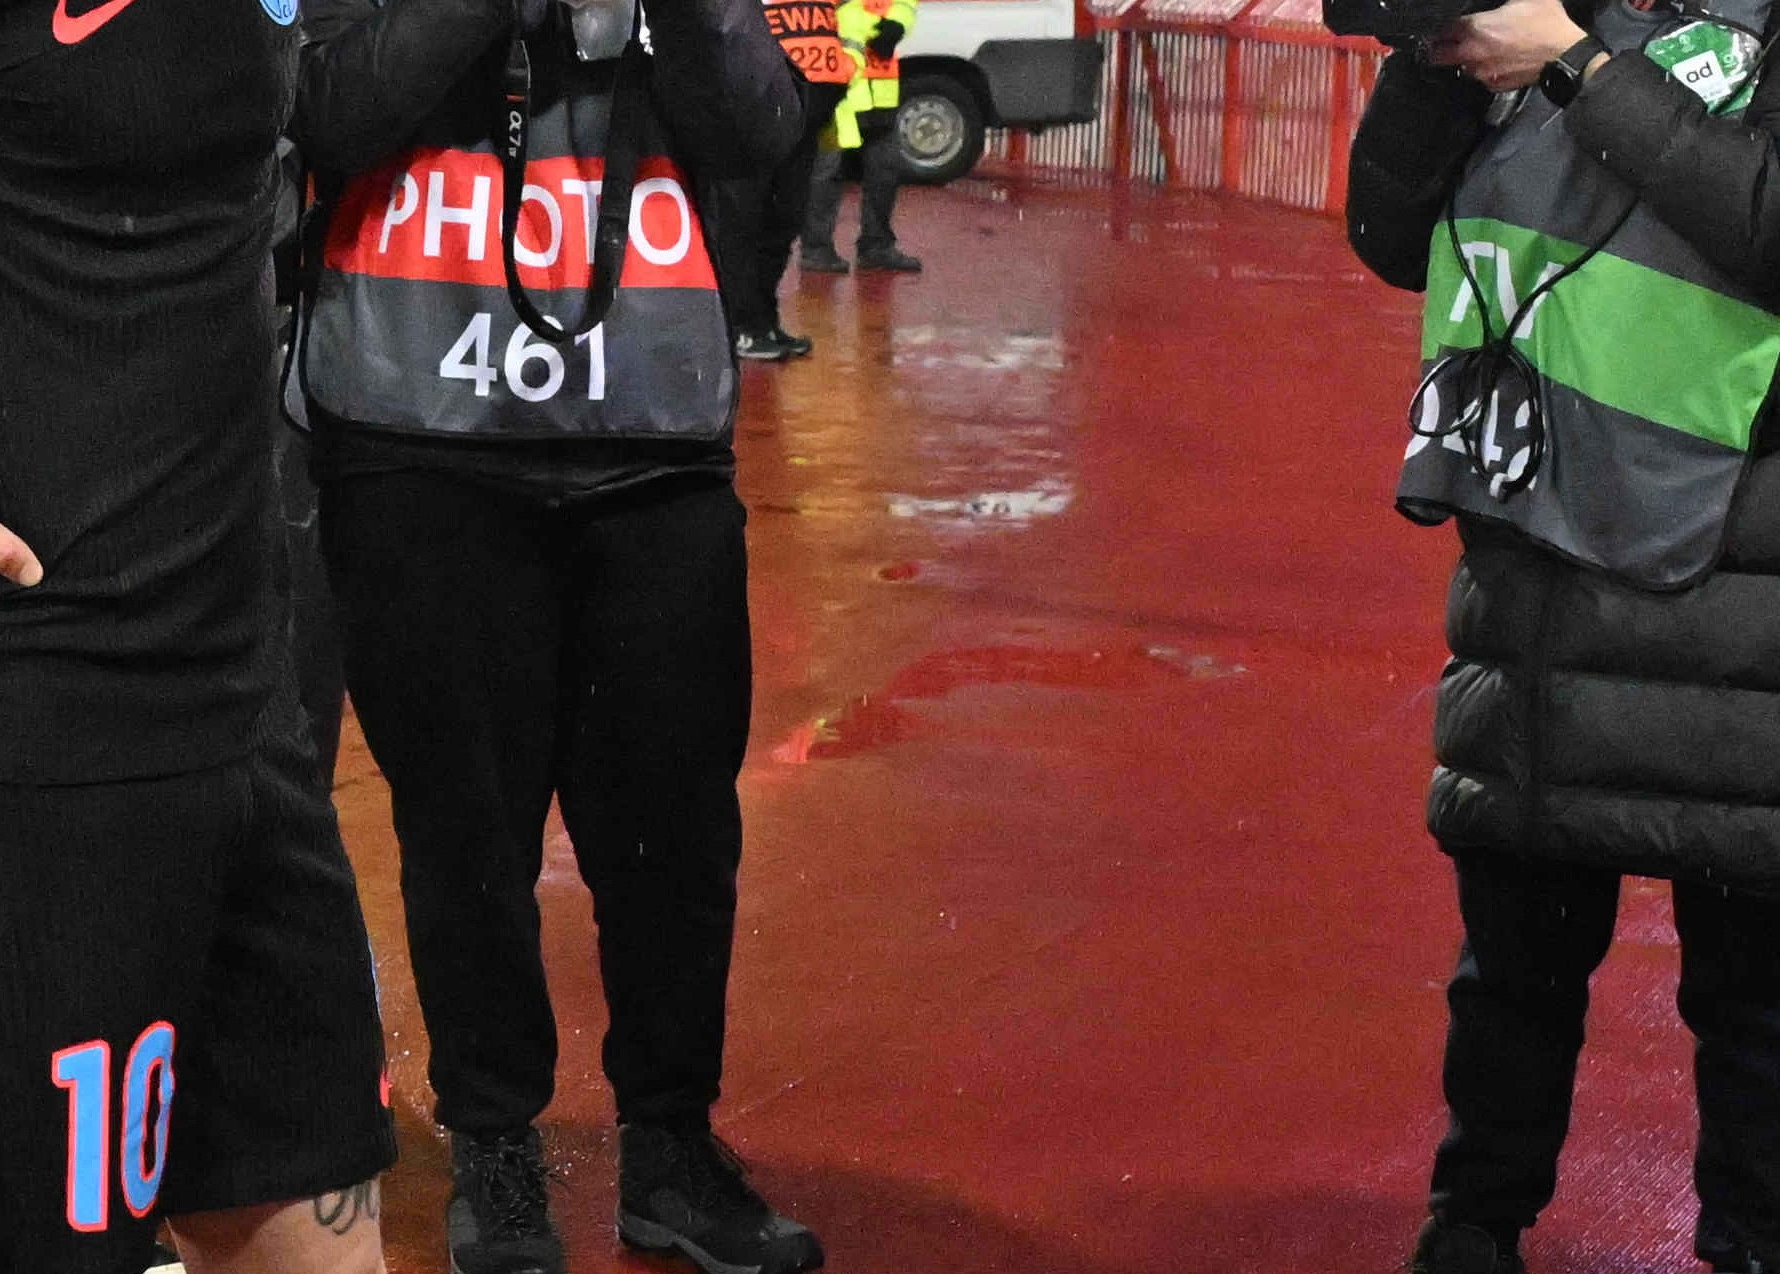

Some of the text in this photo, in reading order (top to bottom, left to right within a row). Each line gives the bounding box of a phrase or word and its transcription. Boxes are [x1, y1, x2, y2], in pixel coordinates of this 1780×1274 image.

[1686, 61, 1714, 84] ad
[379, 171, 691, 268] PHOTO
[439, 312, 606, 402] 461
[51, 1019, 177, 1233] 10
